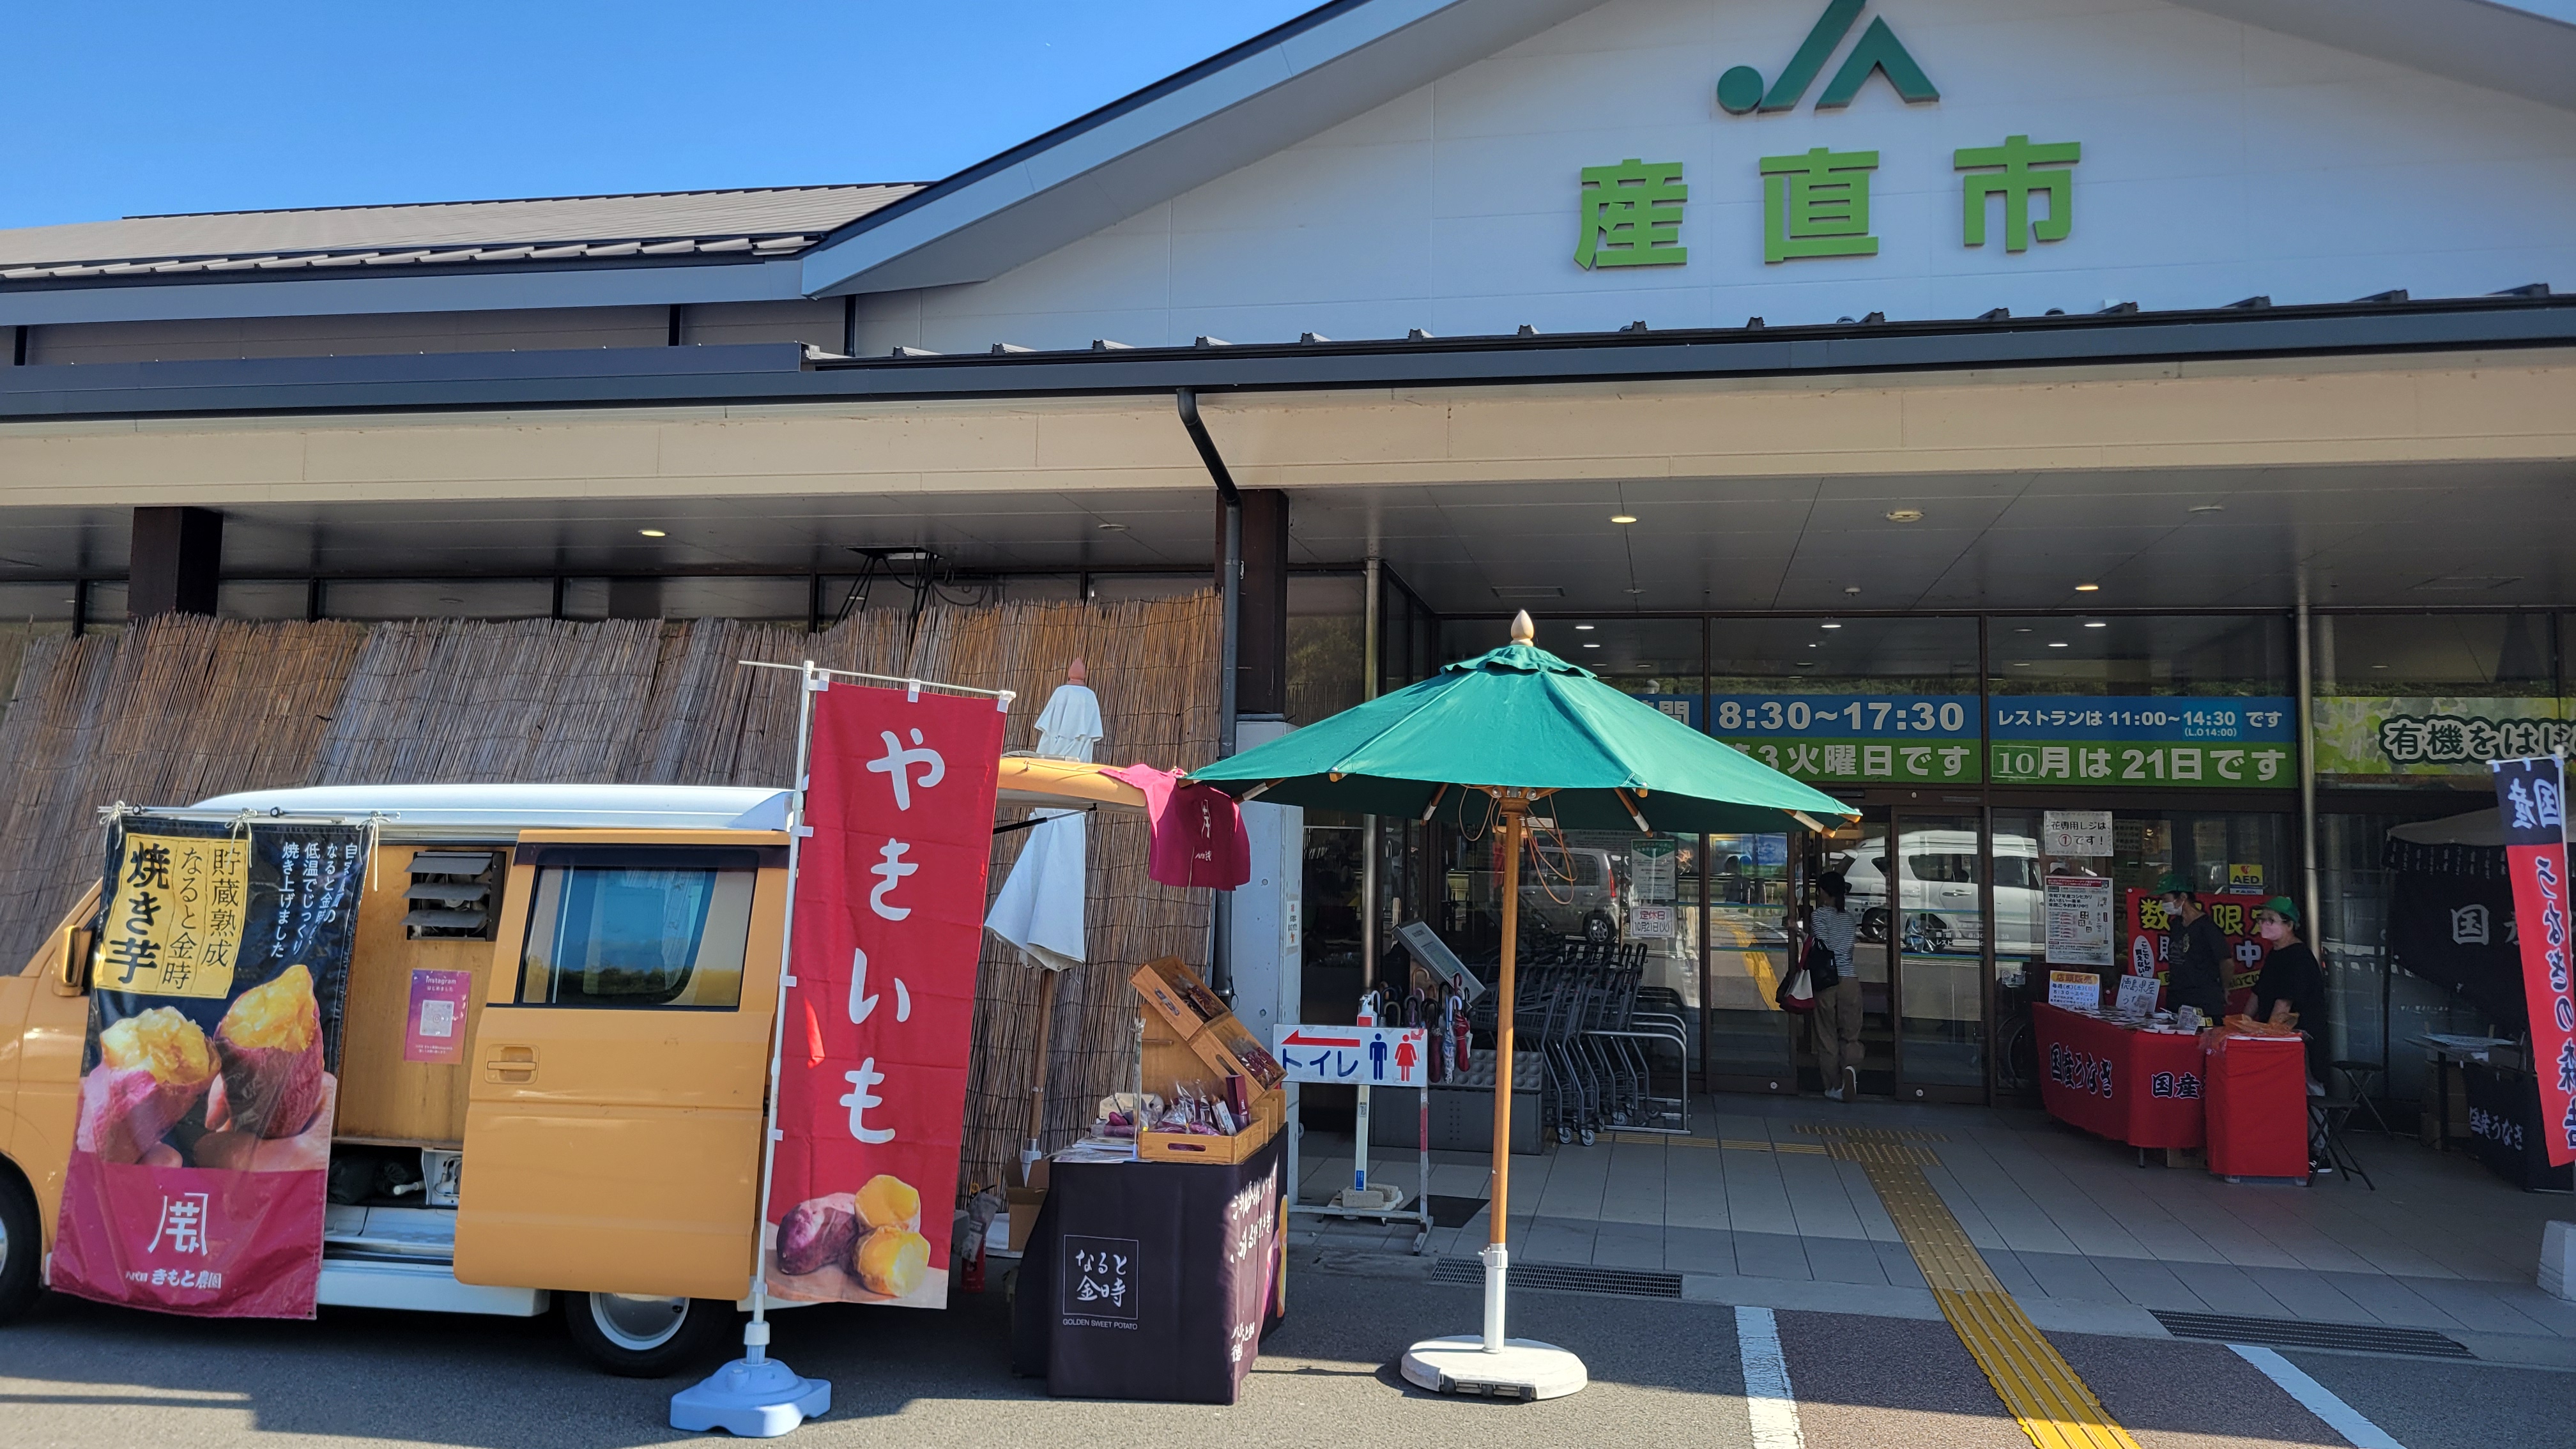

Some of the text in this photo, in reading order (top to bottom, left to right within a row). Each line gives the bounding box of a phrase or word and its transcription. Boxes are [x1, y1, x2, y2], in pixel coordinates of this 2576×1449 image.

[1574, 135, 2082, 271] 産直市
[1719, 702, 1964, 730] 8:30~17:30
[1998, 710, 2103, 727] レストランは
[2246, 710, 2283, 728] です
[2387, 721, 2576, 758] 有機をはじ
[1726, 742, 1970, 778] 3火曜日です
[2051, 821, 2106, 831] 花専用レジは
[2233, 875, 2260, 884] AED
[105, 841, 171, 985] 焼き芋
[201, 847, 241, 968] 貯蔵熟成
[271, 841, 300, 958] 焼き上げました
[293, 841, 321, 956] 低温でじっくり
[162, 847, 203, 990] なると金時
[1634, 921, 1669, 933] 10月21日(火)
[1639, 910, 1666, 920] 定休日
[839, 727, 946, 1144] やきいも
[425, 976, 456, 985] Instagram
[2056, 974, 2093, 984] 店頭販売
[2120, 977, 2156, 995] 徳島県産
[1282, 1047, 1359, 1078] トイレ
[2050, 1041, 2113, 1099] 国産うなぎ
[2150, 1071, 2205, 1100] 国産
[1075, 1249, 1128, 1275] なると
[151, 1268, 222, 1289] きもと農園
[1077, 1275, 1126, 1307] 金時
[1062, 1318, 1138, 1330] GOLDEN SWEET POTATO
